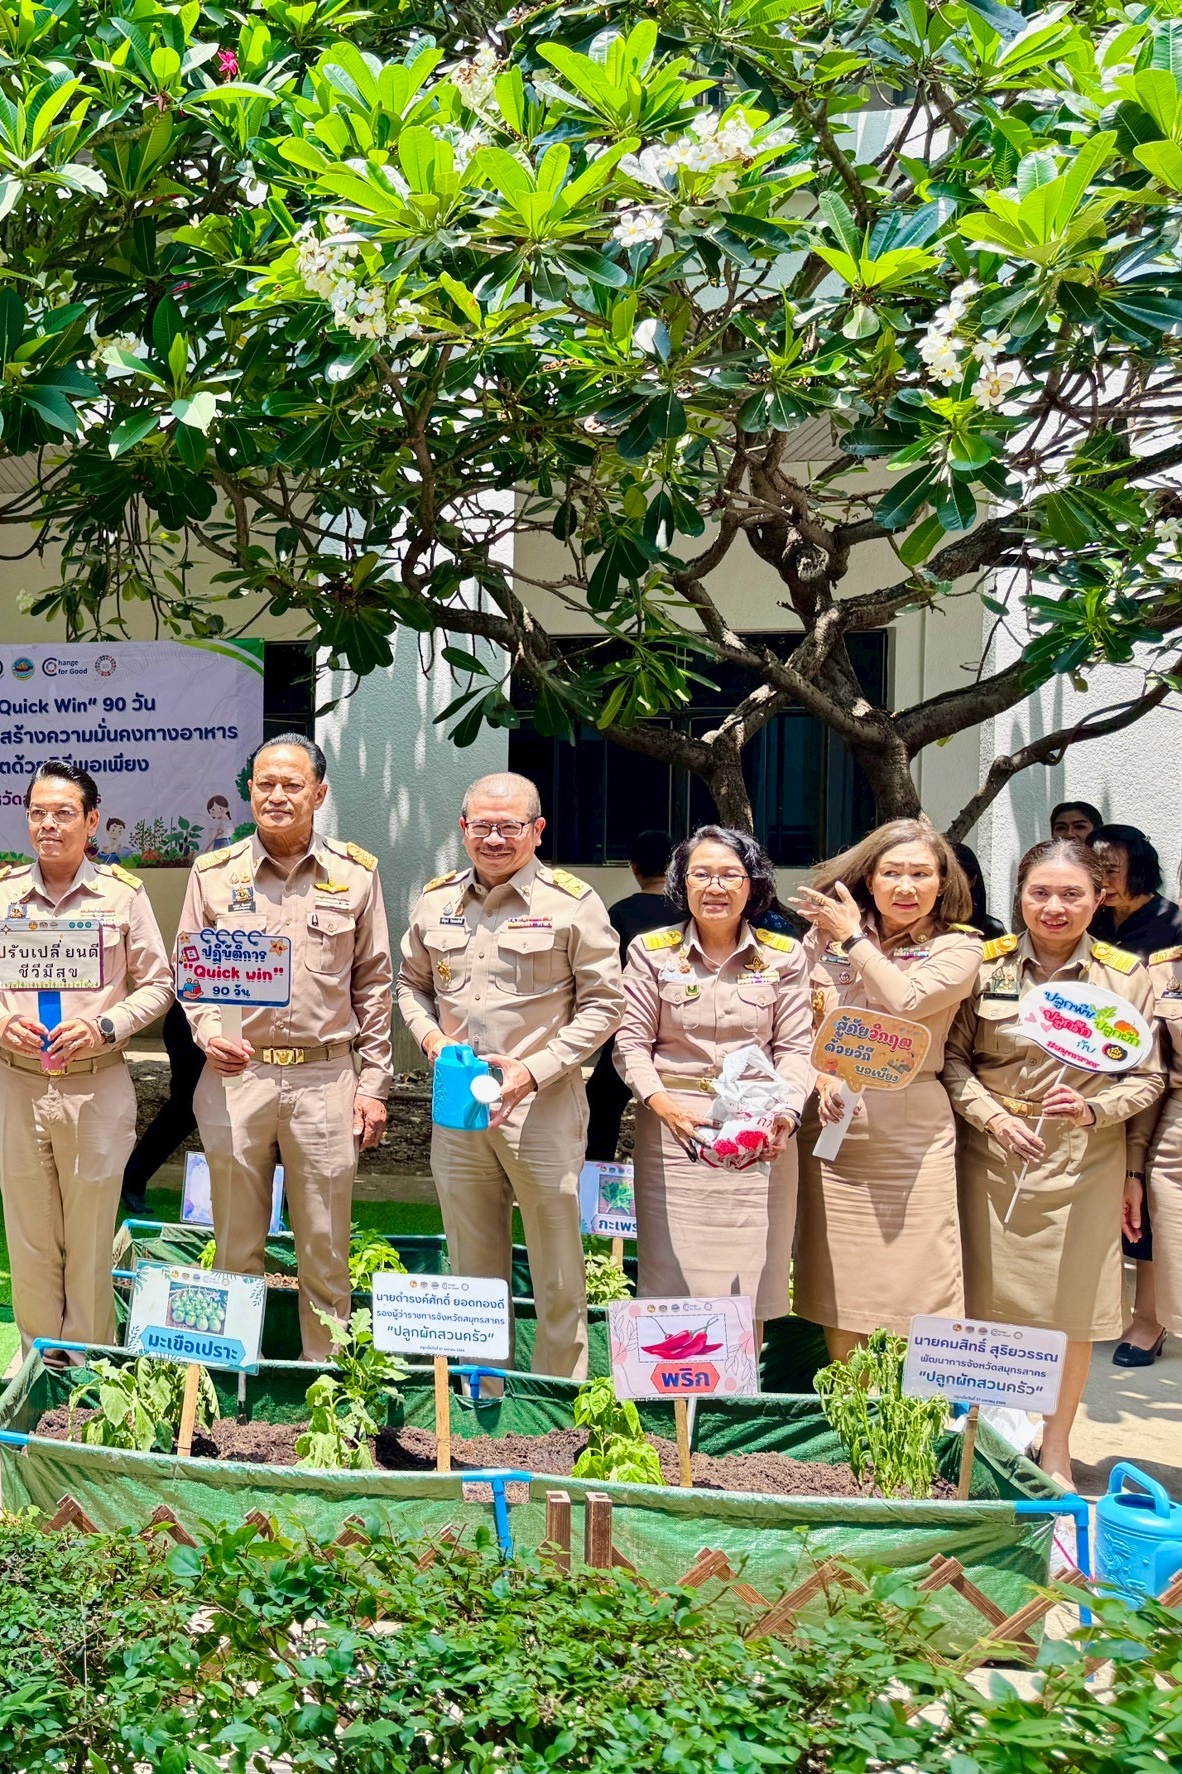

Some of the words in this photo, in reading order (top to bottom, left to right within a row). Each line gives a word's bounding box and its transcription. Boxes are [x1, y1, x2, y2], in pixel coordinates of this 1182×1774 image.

[71, 667, 88, 675] Good
[102, 697, 127, 713] 90
[132, 692, 156, 712] วัน
[212, 986, 230, 996] 90
[233, 984, 251, 998] วัน
[1044, 991, 1096, 1019] ปลูกพืช
[1043, 1009, 1093, 1038] ปลูกรัก
[598, 1219, 638, 1233] กะเพร
[453, 1298, 505, 1310] ยอดทองดี
[148, 1334, 238, 1360] มะเขือเปราะ
[914, 1335, 987, 1354] นายคมสิทธิ์
[990, 1344, 1059, 1362] สุริยวรรณ
[661, 1367, 710, 1388] พริก
